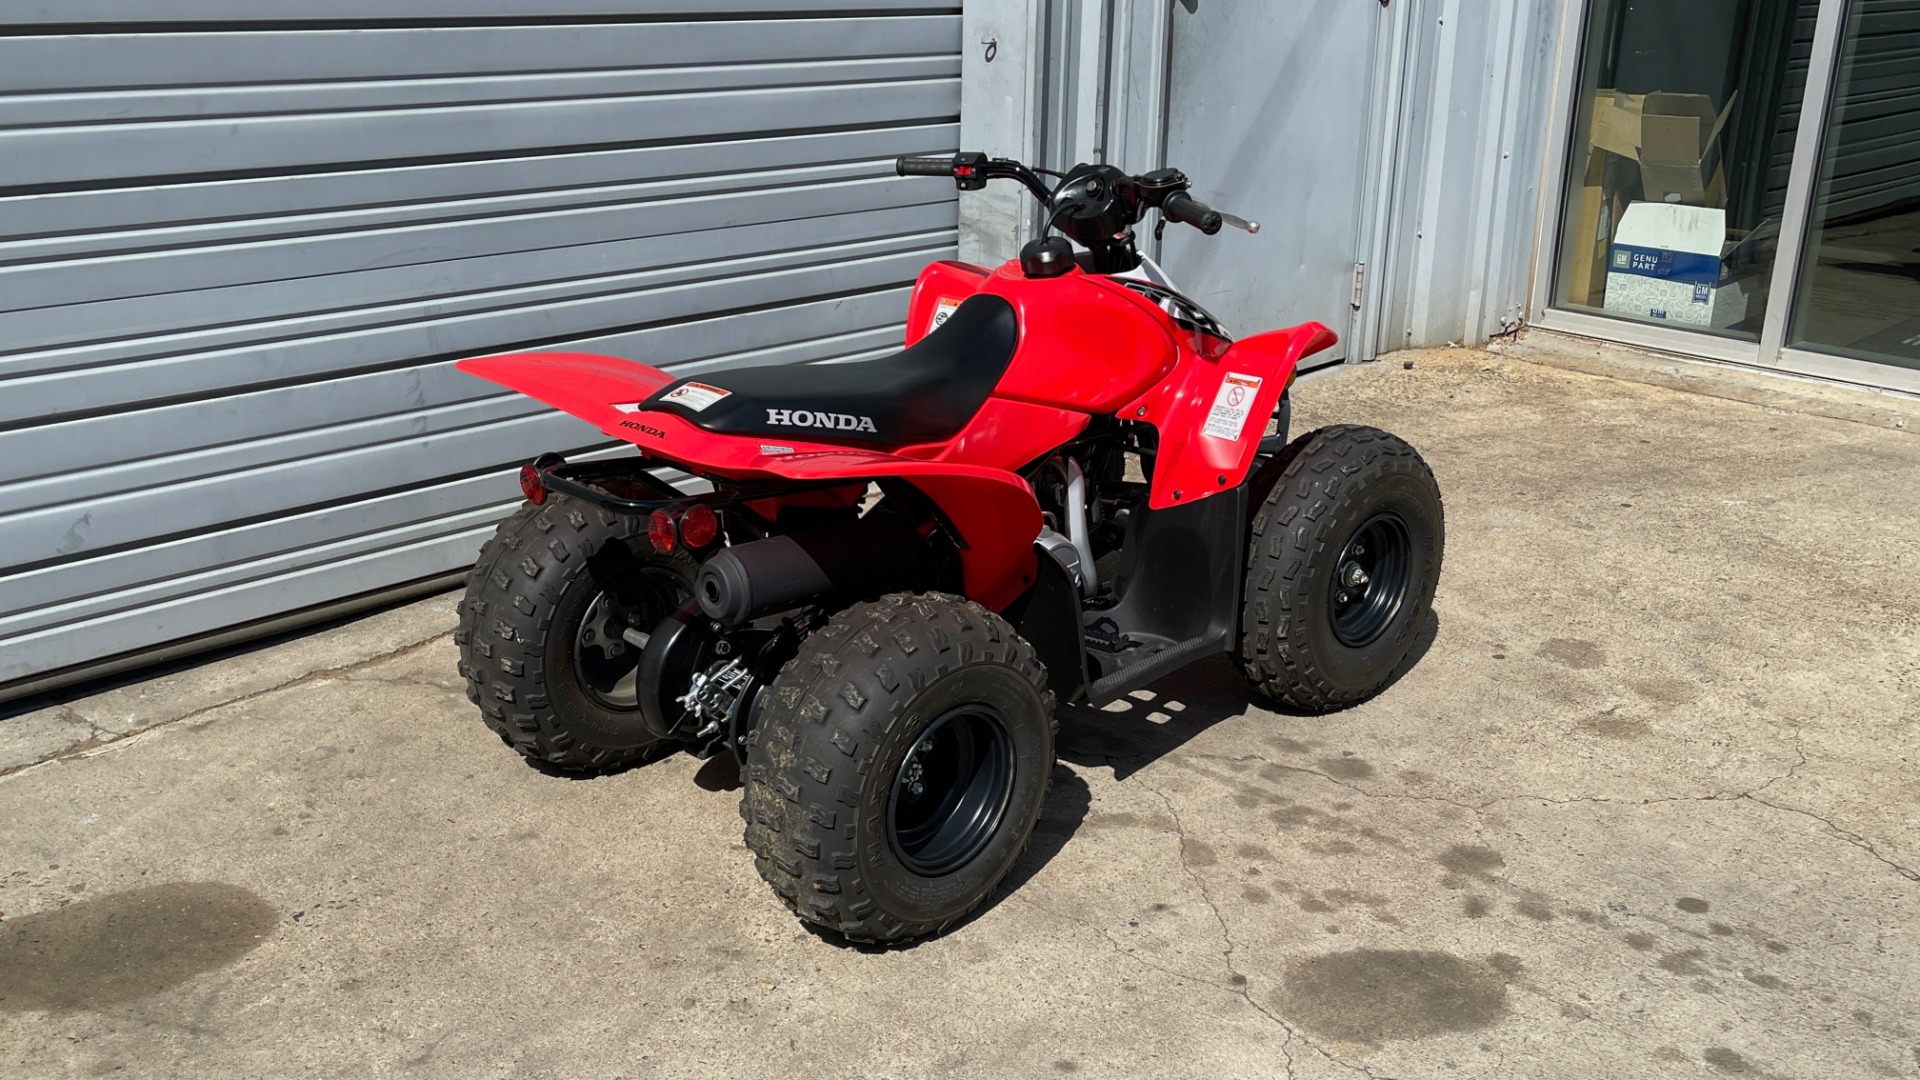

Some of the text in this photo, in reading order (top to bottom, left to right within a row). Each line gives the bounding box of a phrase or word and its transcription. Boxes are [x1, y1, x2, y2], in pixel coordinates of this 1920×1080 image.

[1617, 253, 1627, 262] GM
[1633, 253, 1658, 263] GENU
[1632, 262, 1656, 271] PART
[1696, 286, 1708, 295] GM
[766, 409, 878, 434] HONDA
[618, 420, 666, 439] HONDA
